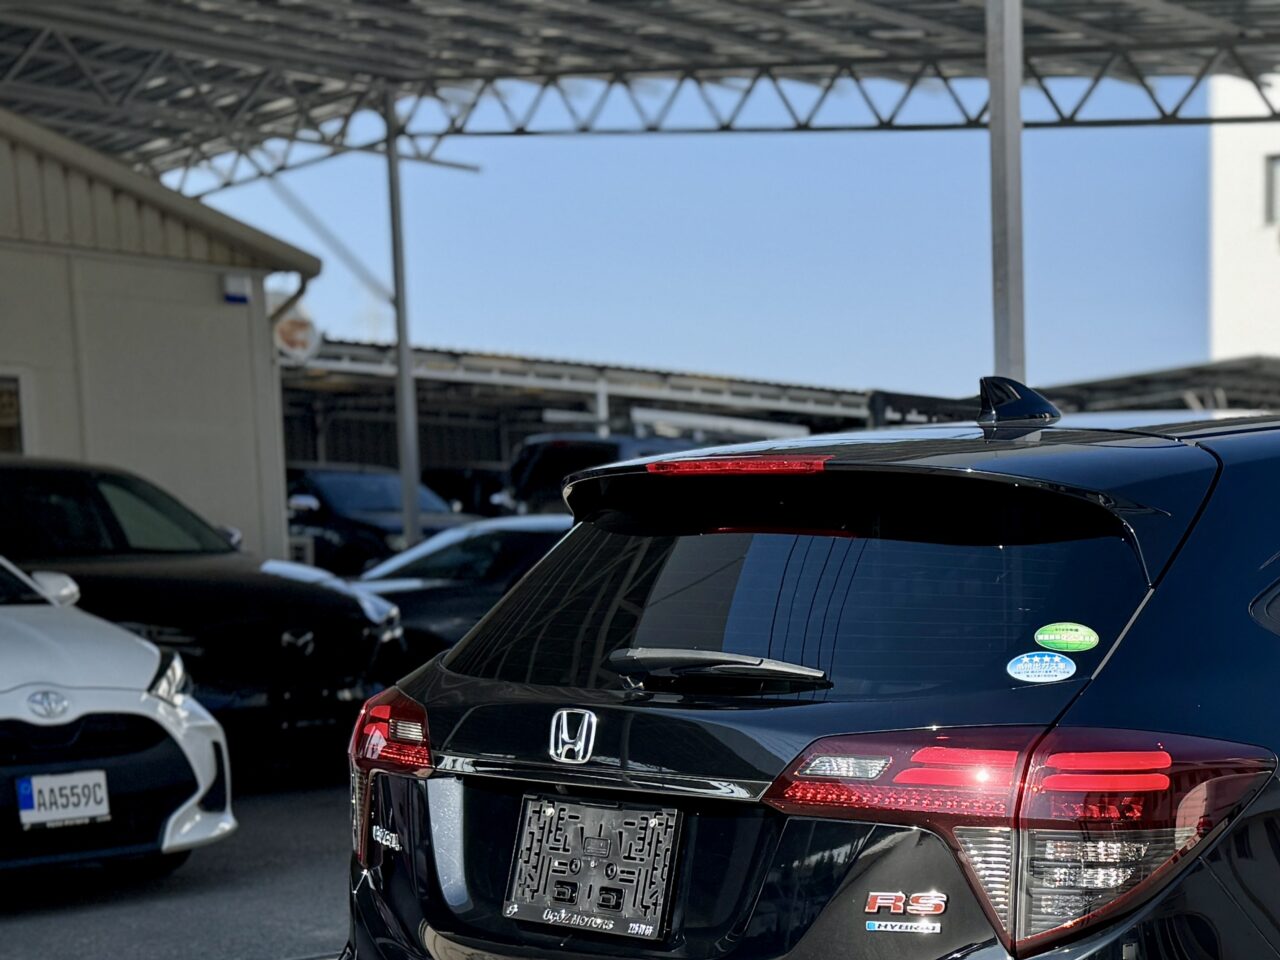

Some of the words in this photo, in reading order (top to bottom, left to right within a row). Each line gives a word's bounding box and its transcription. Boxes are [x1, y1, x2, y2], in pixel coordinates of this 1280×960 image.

[37, 783, 104, 812] AA559C
[864, 891, 947, 915] RS
[877, 923, 936, 931] HYBRD
